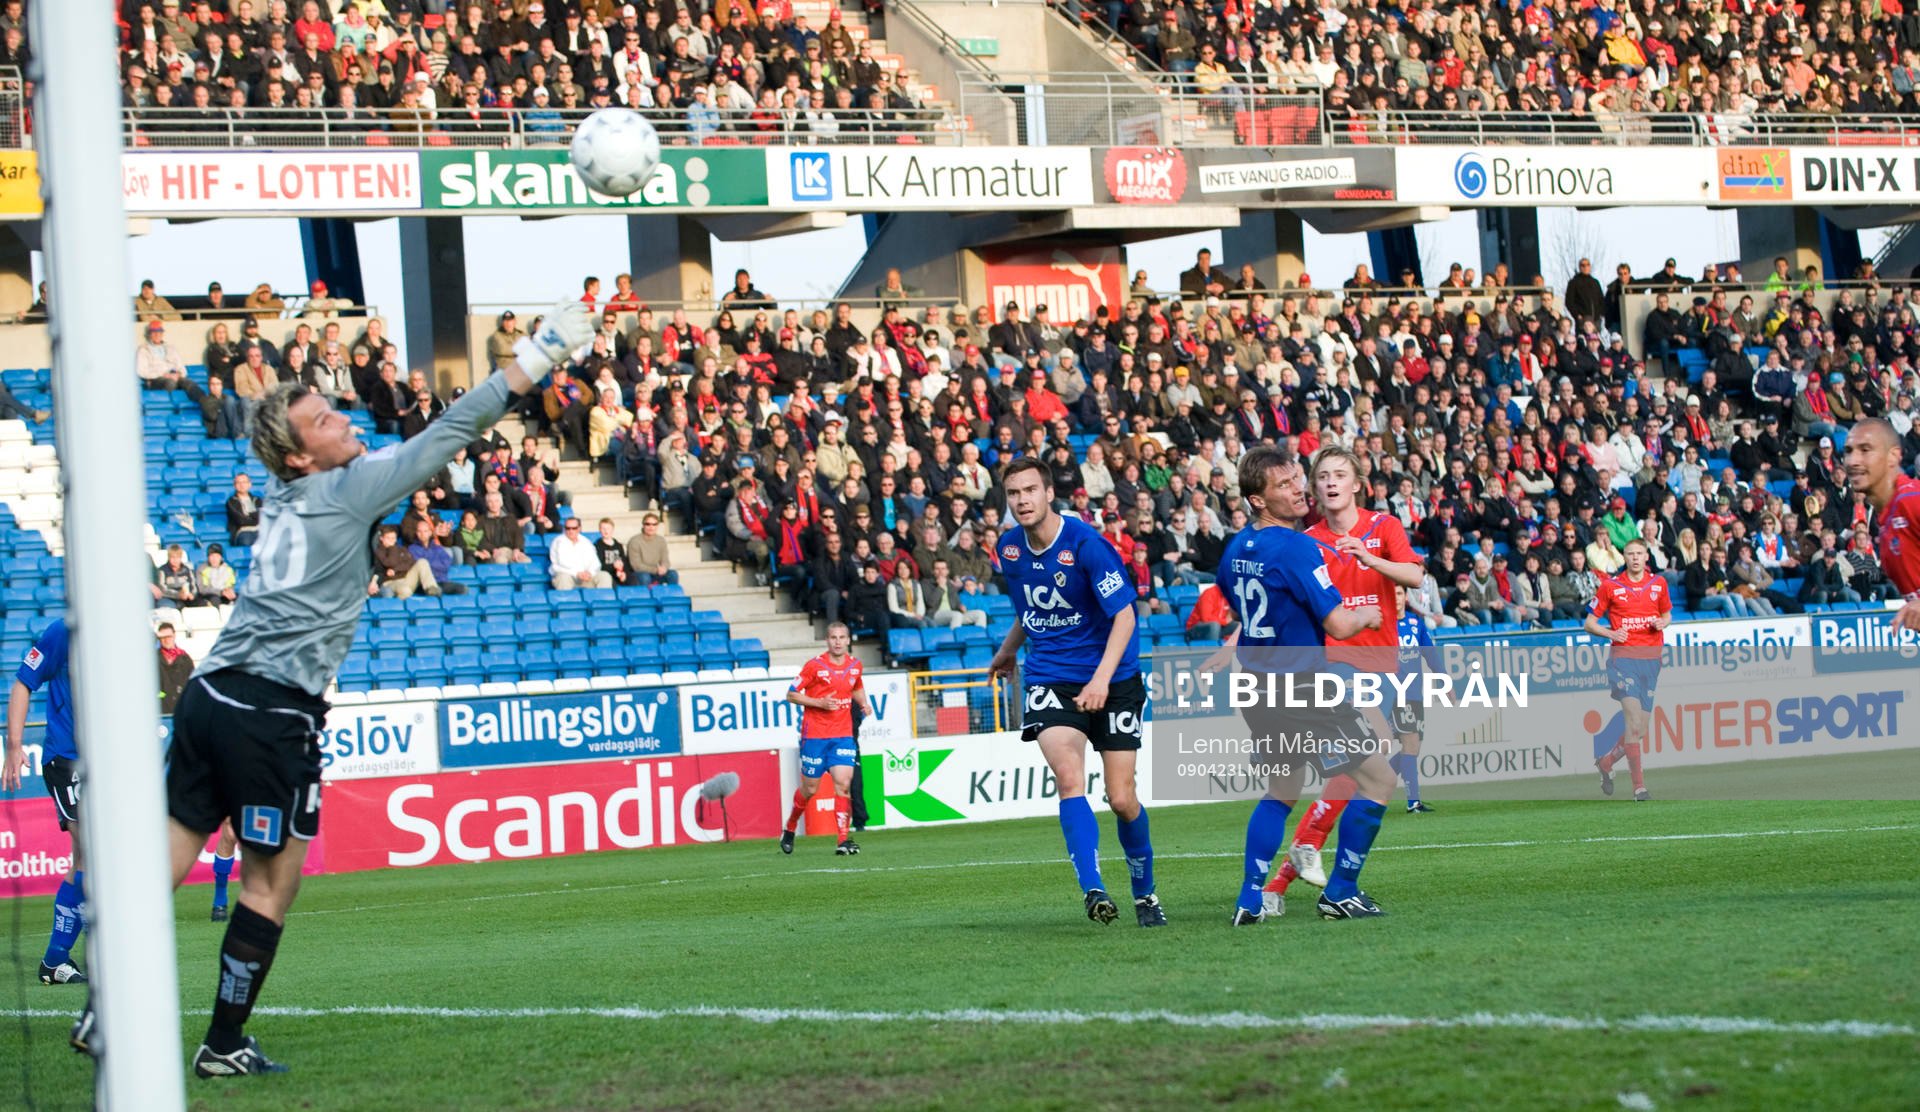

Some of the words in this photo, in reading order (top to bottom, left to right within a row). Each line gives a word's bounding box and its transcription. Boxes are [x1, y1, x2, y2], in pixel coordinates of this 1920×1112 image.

[161, 164, 220, 200] HIF
[257, 163, 412, 200] LOTTEN!
[843, 155, 890, 197] LK
[901, 155, 1069, 197] Armatur
[1205, 170, 1236, 186] INTE
[1493, 157, 1614, 196] Brinova
[1803, 157, 1901, 192] DIN-X
[1117, 184, 1173, 200] MEGAPOL
[1032, 561, 1045, 570] ICA
[1232, 558, 1264, 577] GETINGE
[1023, 584, 1073, 610] ICA
[1233, 576, 1276, 638] 12
[1022, 610, 1083, 634] Kundkort
[588, 737, 661, 752] vardagsglädje
[387, 761, 725, 867] Scandic
